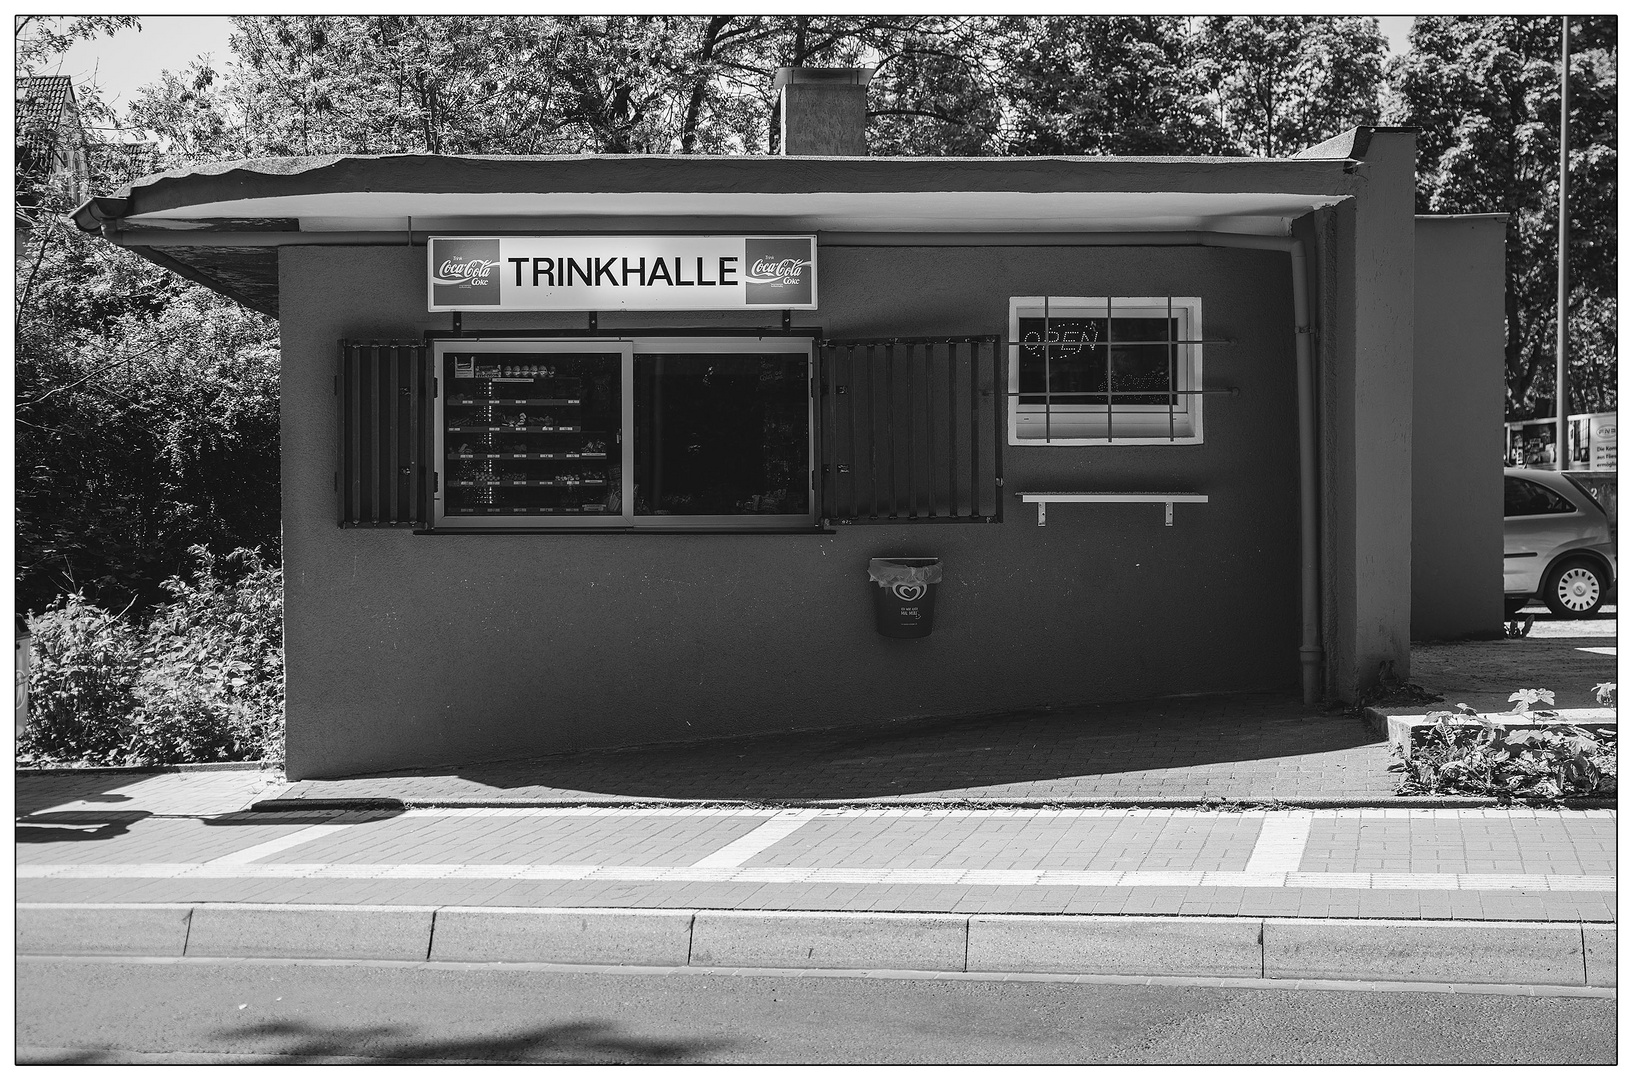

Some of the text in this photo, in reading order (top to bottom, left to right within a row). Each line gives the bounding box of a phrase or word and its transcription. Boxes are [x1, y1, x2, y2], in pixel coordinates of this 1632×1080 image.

[439, 260, 492, 278] Coca-Cola
[507, 257, 738, 286] TRINKHALLE
[751, 259, 803, 277] Coca-Cola
[471, 278, 489, 286] Coke
[783, 277, 800, 285] Coke
[1024, 331, 1099, 350] OPEN
